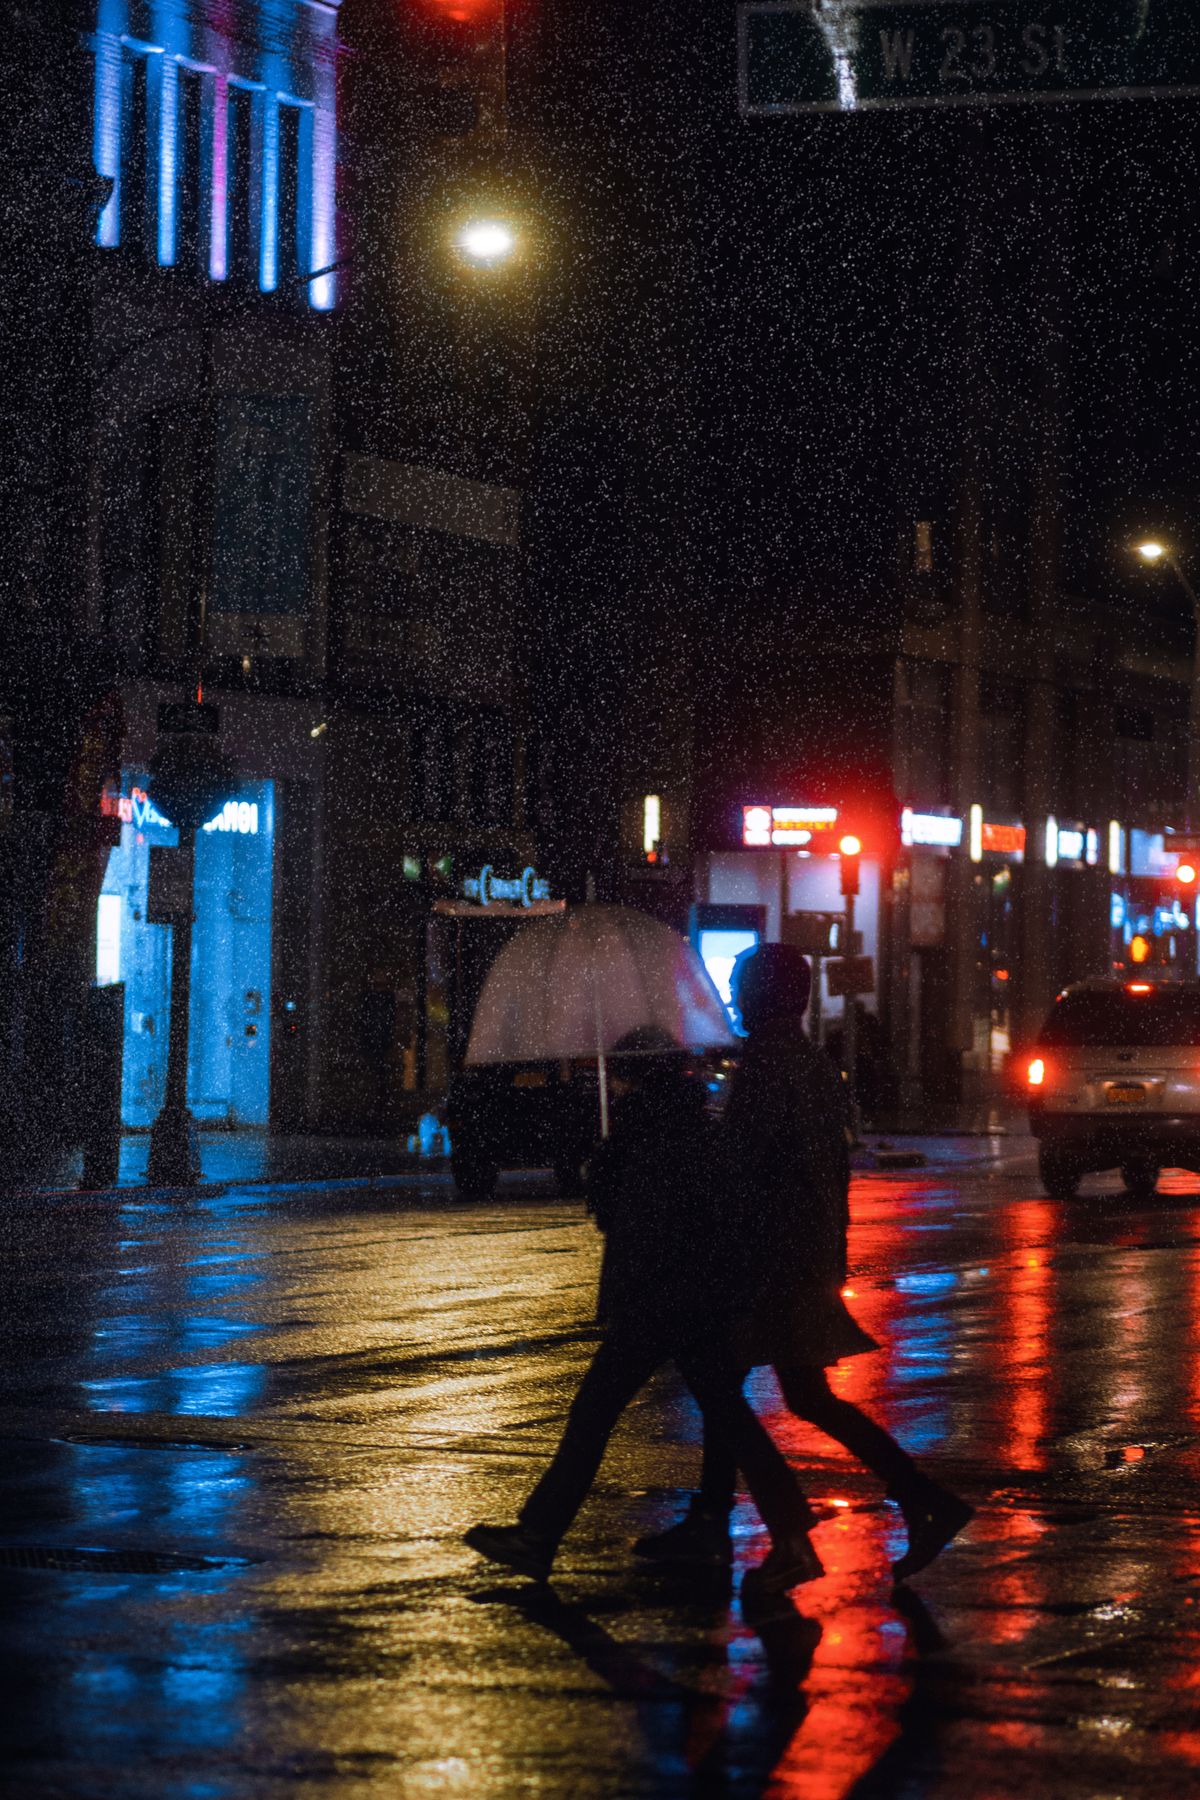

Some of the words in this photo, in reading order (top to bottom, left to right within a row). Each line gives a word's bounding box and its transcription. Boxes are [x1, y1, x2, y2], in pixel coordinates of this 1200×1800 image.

[879, 29, 915, 81] W
[938, 25, 996, 80] 23
[1020, 23, 1068, 74] St
